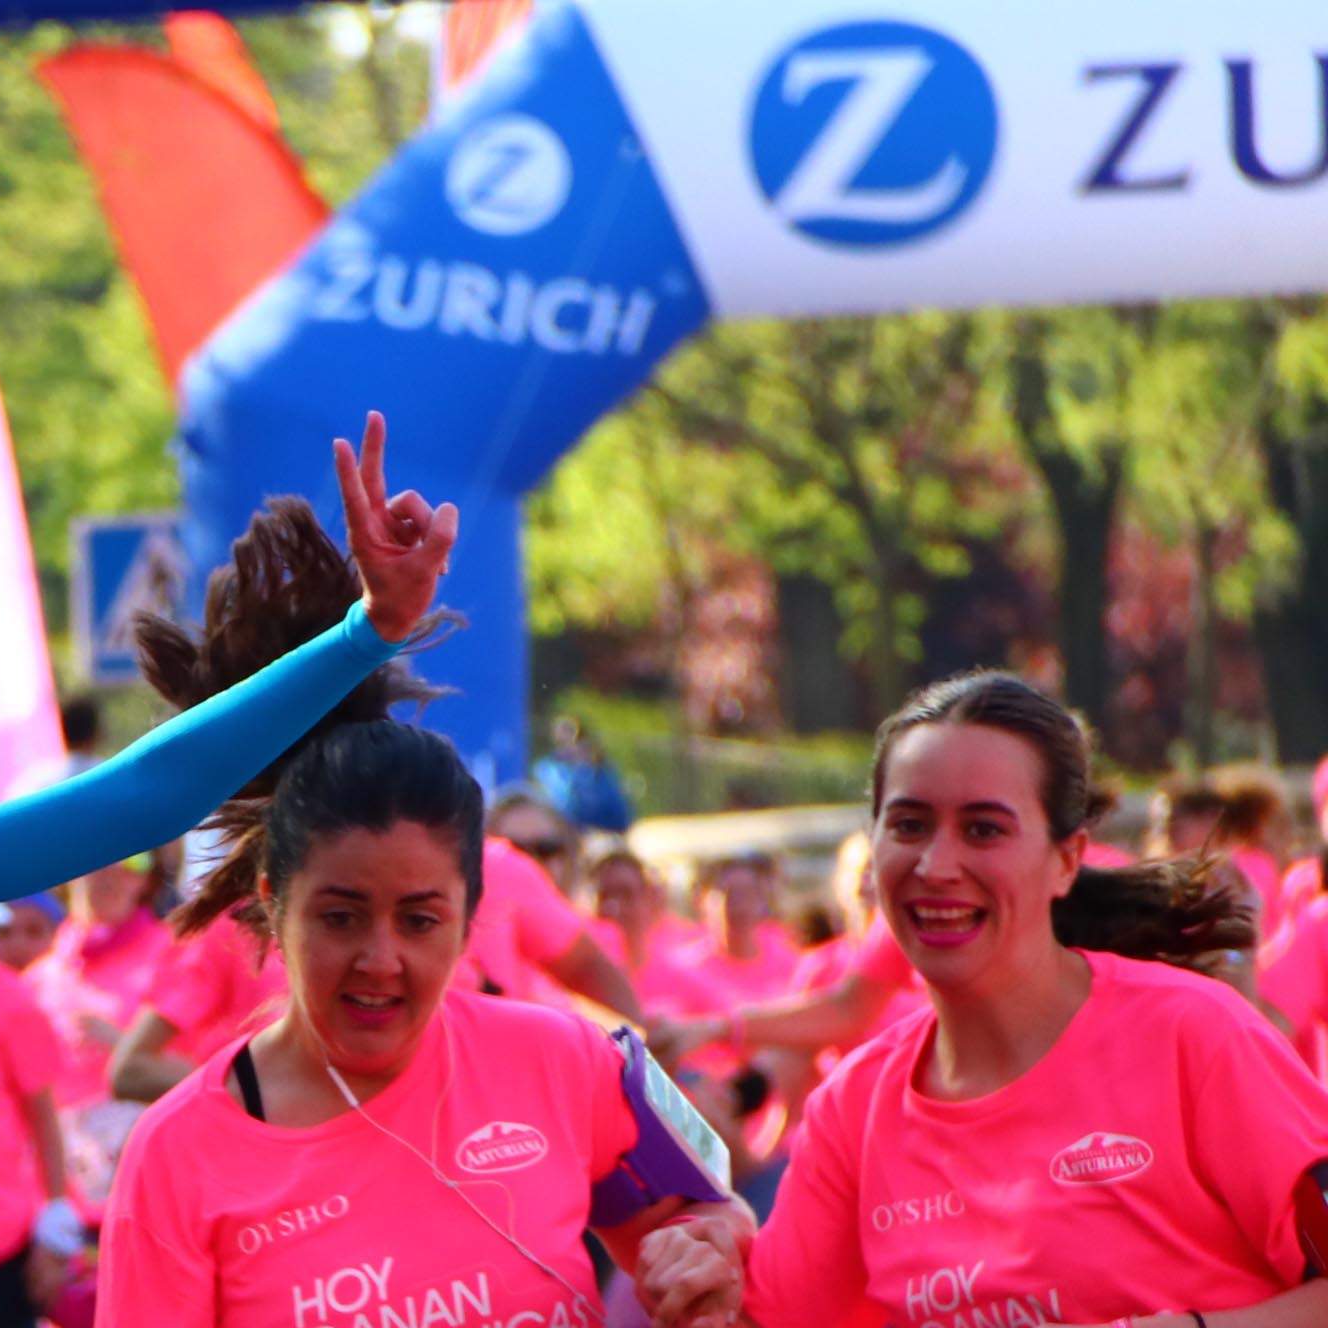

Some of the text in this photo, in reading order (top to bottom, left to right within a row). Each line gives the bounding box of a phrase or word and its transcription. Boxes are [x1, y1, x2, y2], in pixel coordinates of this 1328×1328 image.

[1080, 53, 1328, 194] ZU
[312, 250, 656, 356] ZURICH
[905, 1259, 985, 1321] HOY
